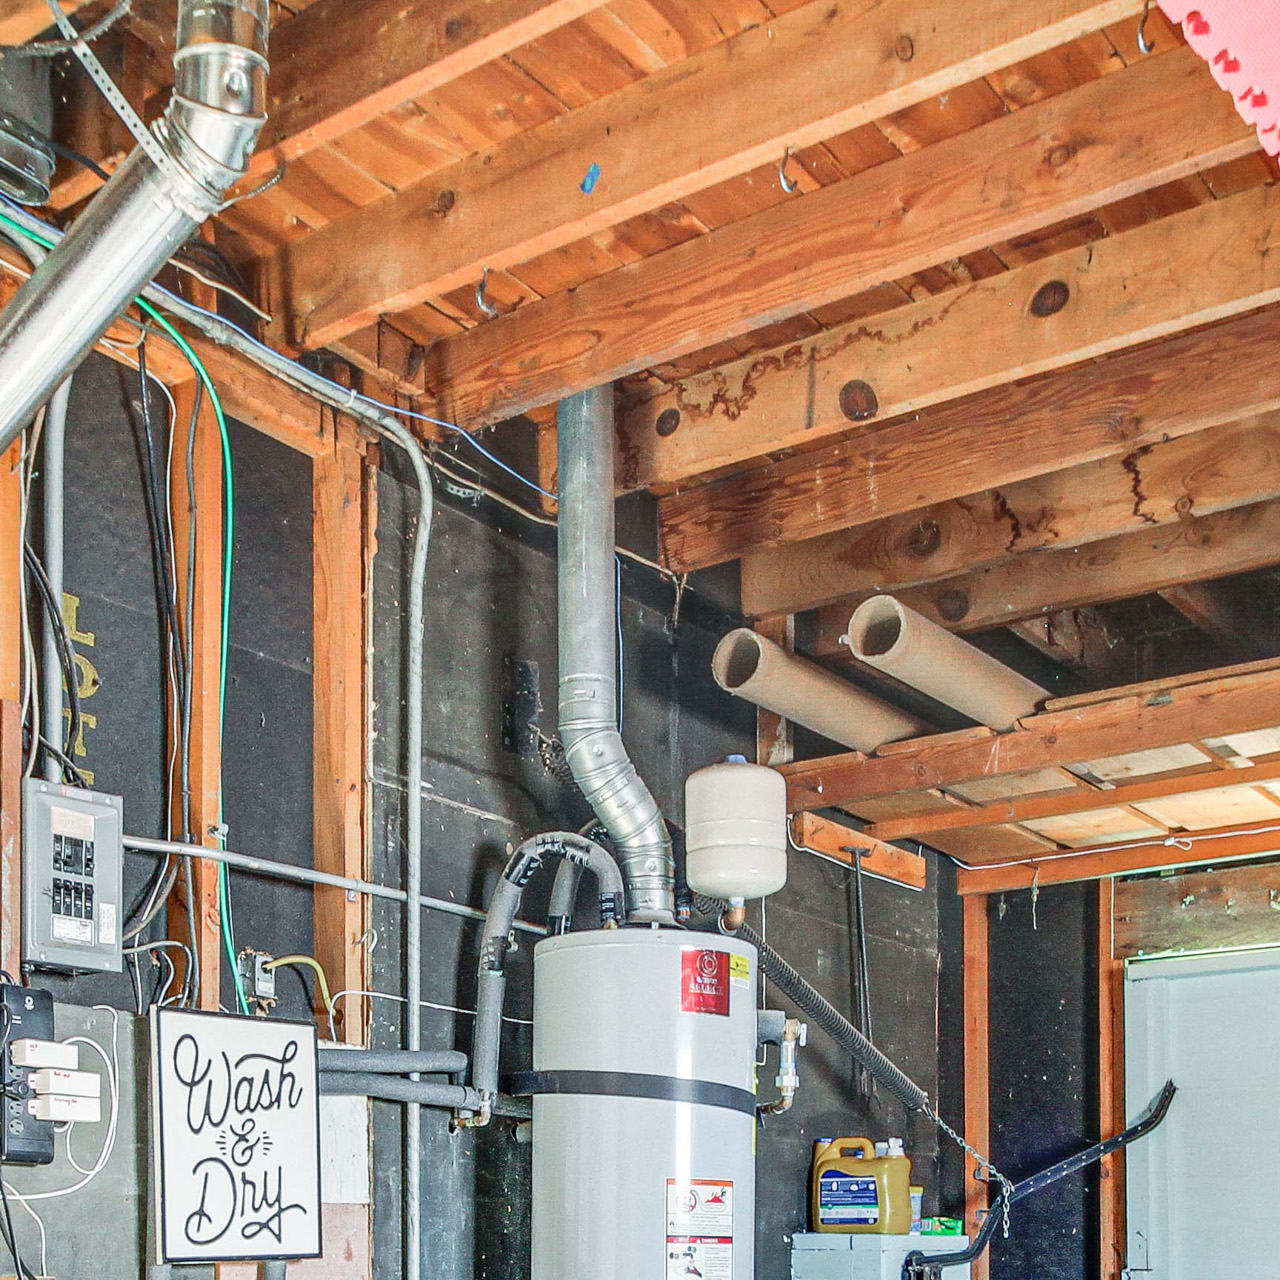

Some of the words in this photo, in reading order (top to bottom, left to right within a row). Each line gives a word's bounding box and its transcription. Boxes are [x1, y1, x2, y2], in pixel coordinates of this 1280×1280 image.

[173, 1033, 304, 1134] Wash
[230, 1118, 261, 1167] &
[184, 1157, 308, 1245] Dry
